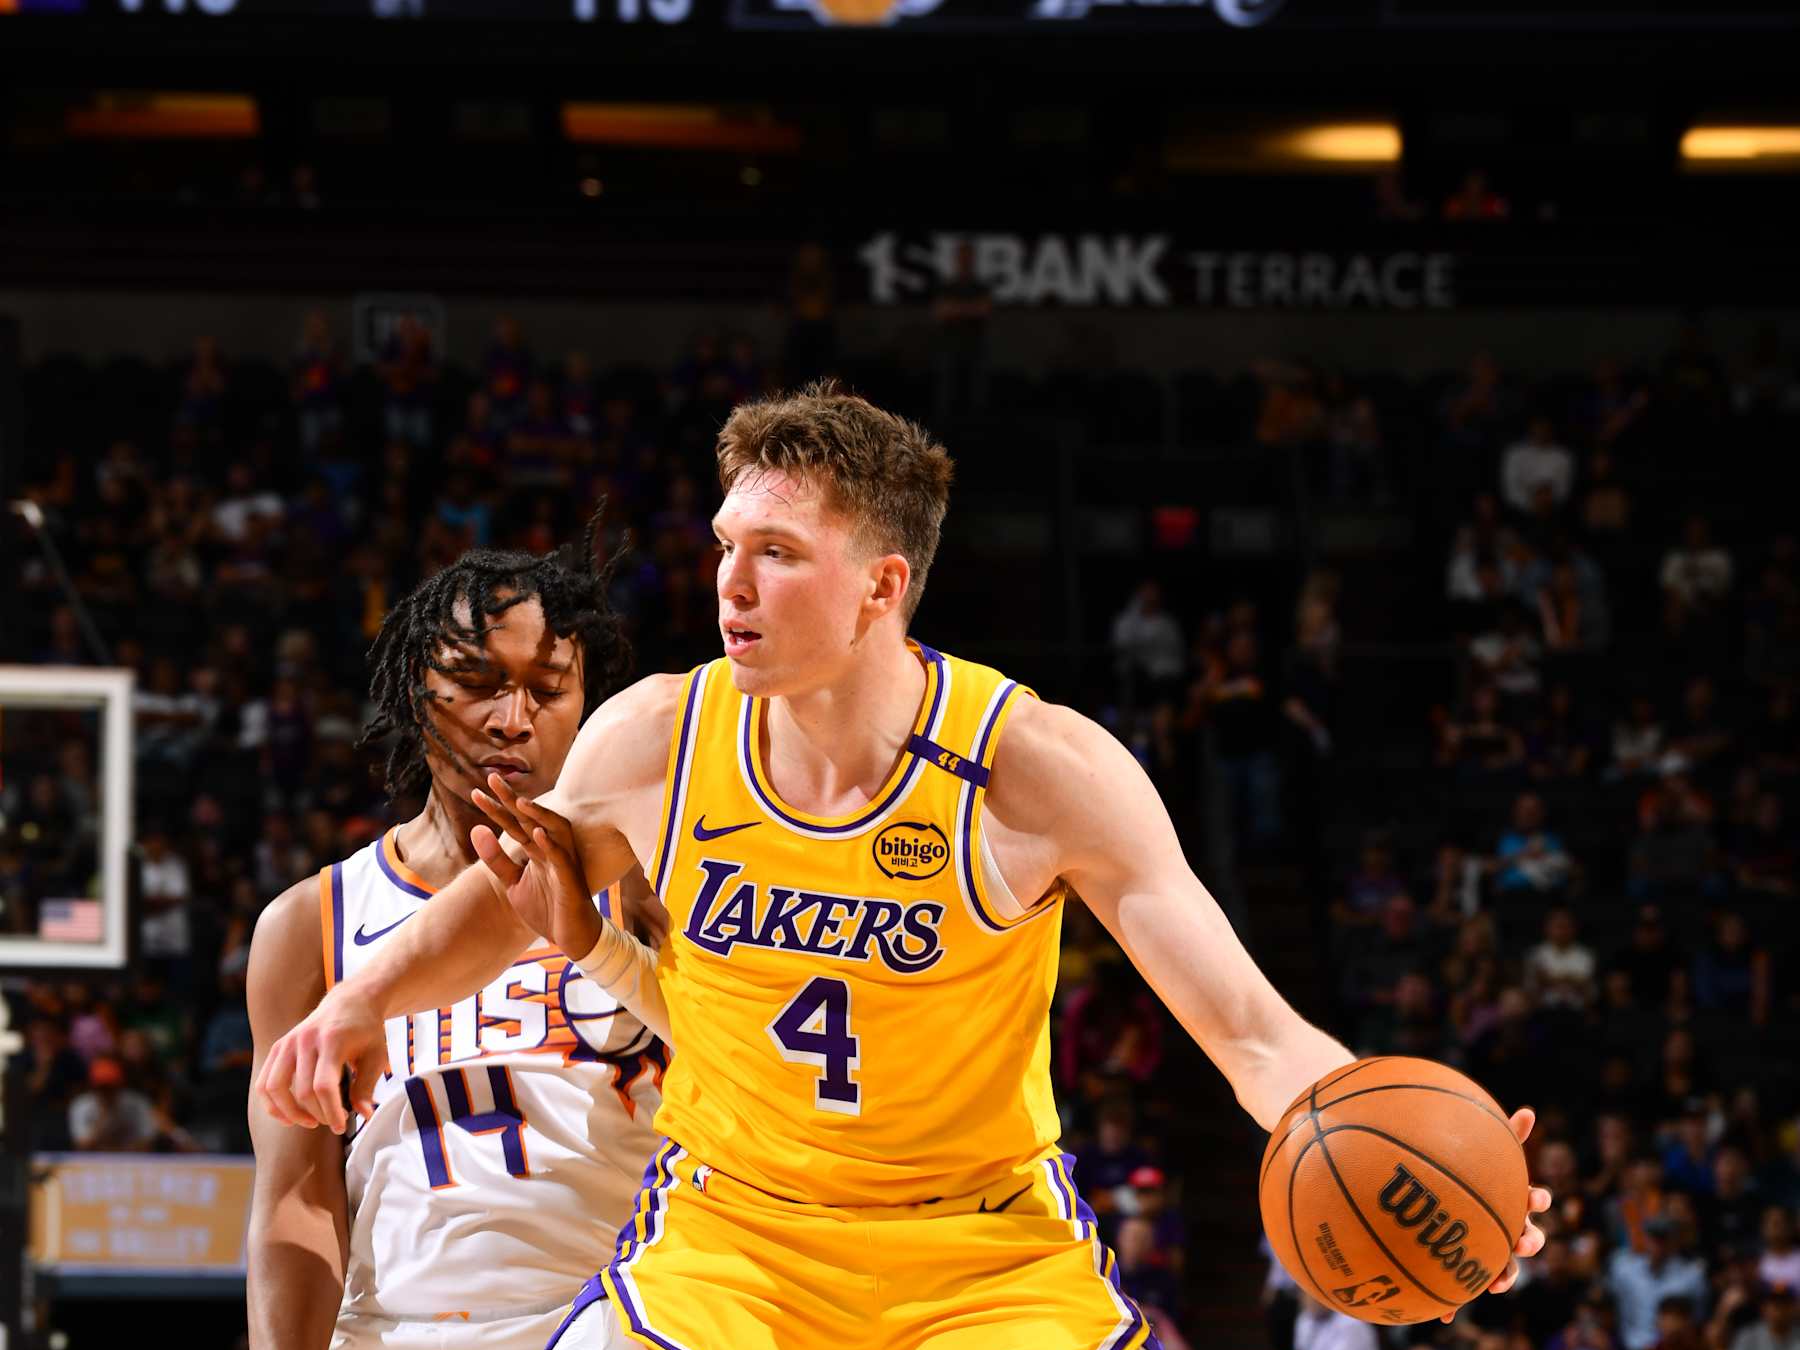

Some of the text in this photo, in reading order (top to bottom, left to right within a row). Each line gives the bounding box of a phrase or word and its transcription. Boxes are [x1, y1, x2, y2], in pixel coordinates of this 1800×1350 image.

[1187, 252, 1454, 304] TERRACE
[938, 751, 960, 771] 44
[880, 836, 945, 864] bibigo
[891, 857, 918, 867] 비비고
[681, 857, 947, 975] LAKERS
[764, 975, 861, 1116] 4
[405, 1066, 529, 1191] 14
[1378, 1163, 1490, 1293] Wilson
